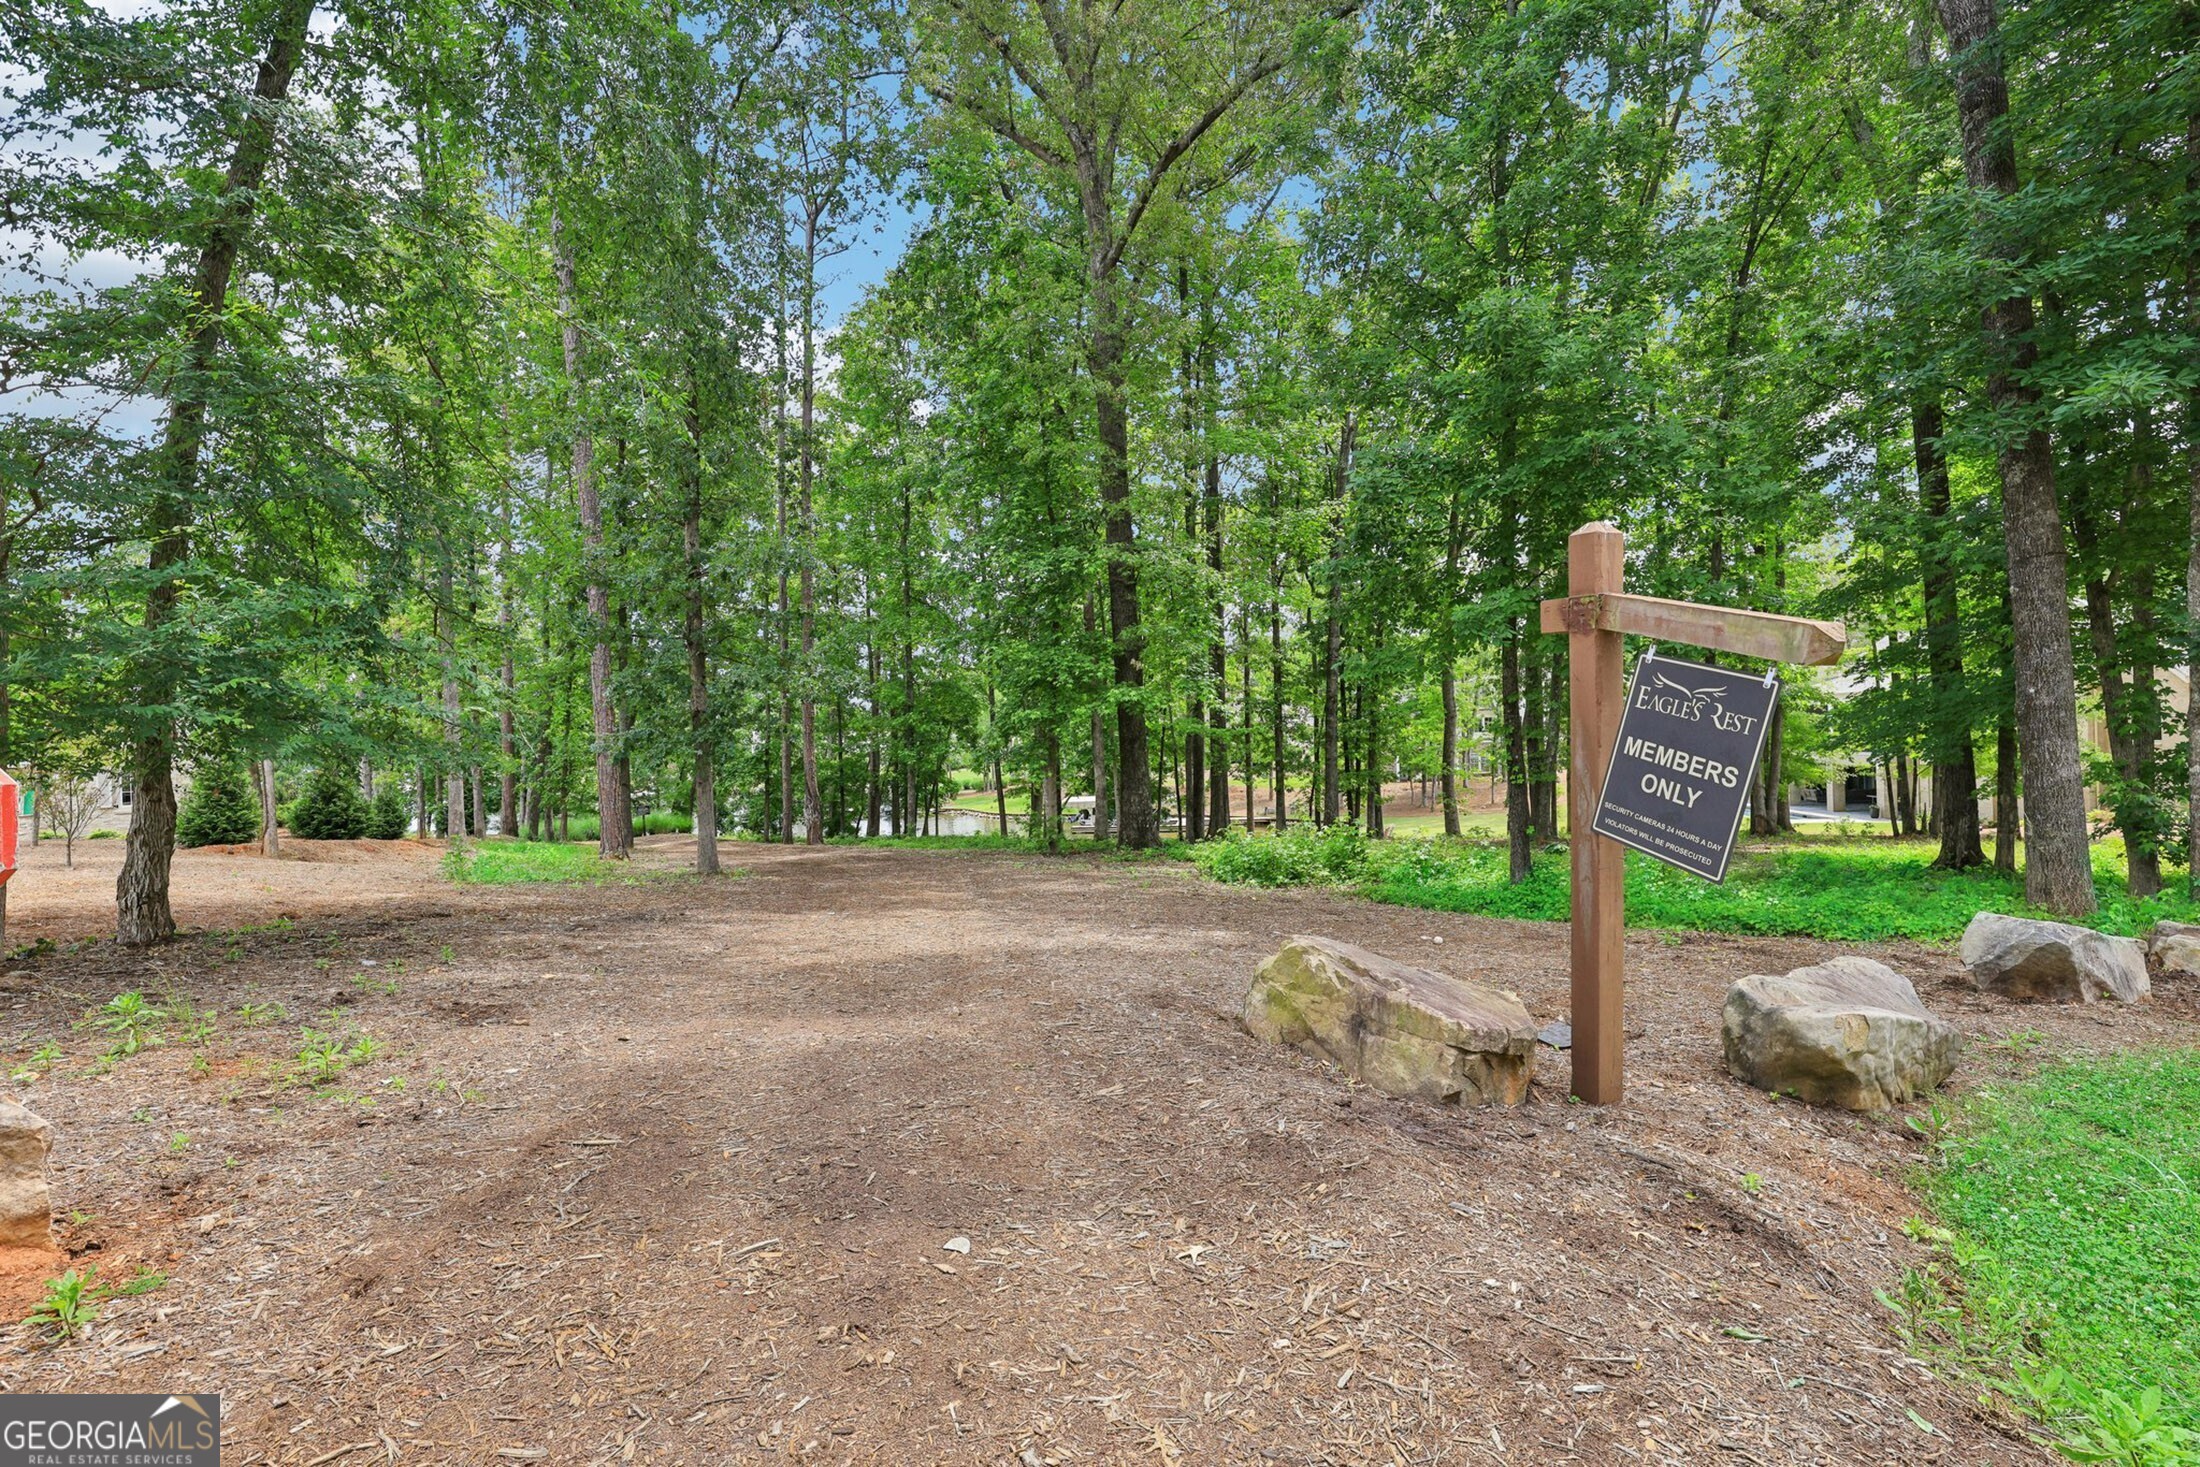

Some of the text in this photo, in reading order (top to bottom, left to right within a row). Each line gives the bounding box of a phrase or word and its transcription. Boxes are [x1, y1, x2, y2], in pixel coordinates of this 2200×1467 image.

[1635, 685, 1758, 735] EAGLE'S REST
[1623, 736, 1739, 788] MEMBERS
[1641, 774, 1703, 809] ONLY
[1604, 801, 1723, 852] SECURITY CAMERAS 24 HOURS A DAY
[1604, 817, 1712, 866] VIOLATORS WILL BE PROSECUTED
